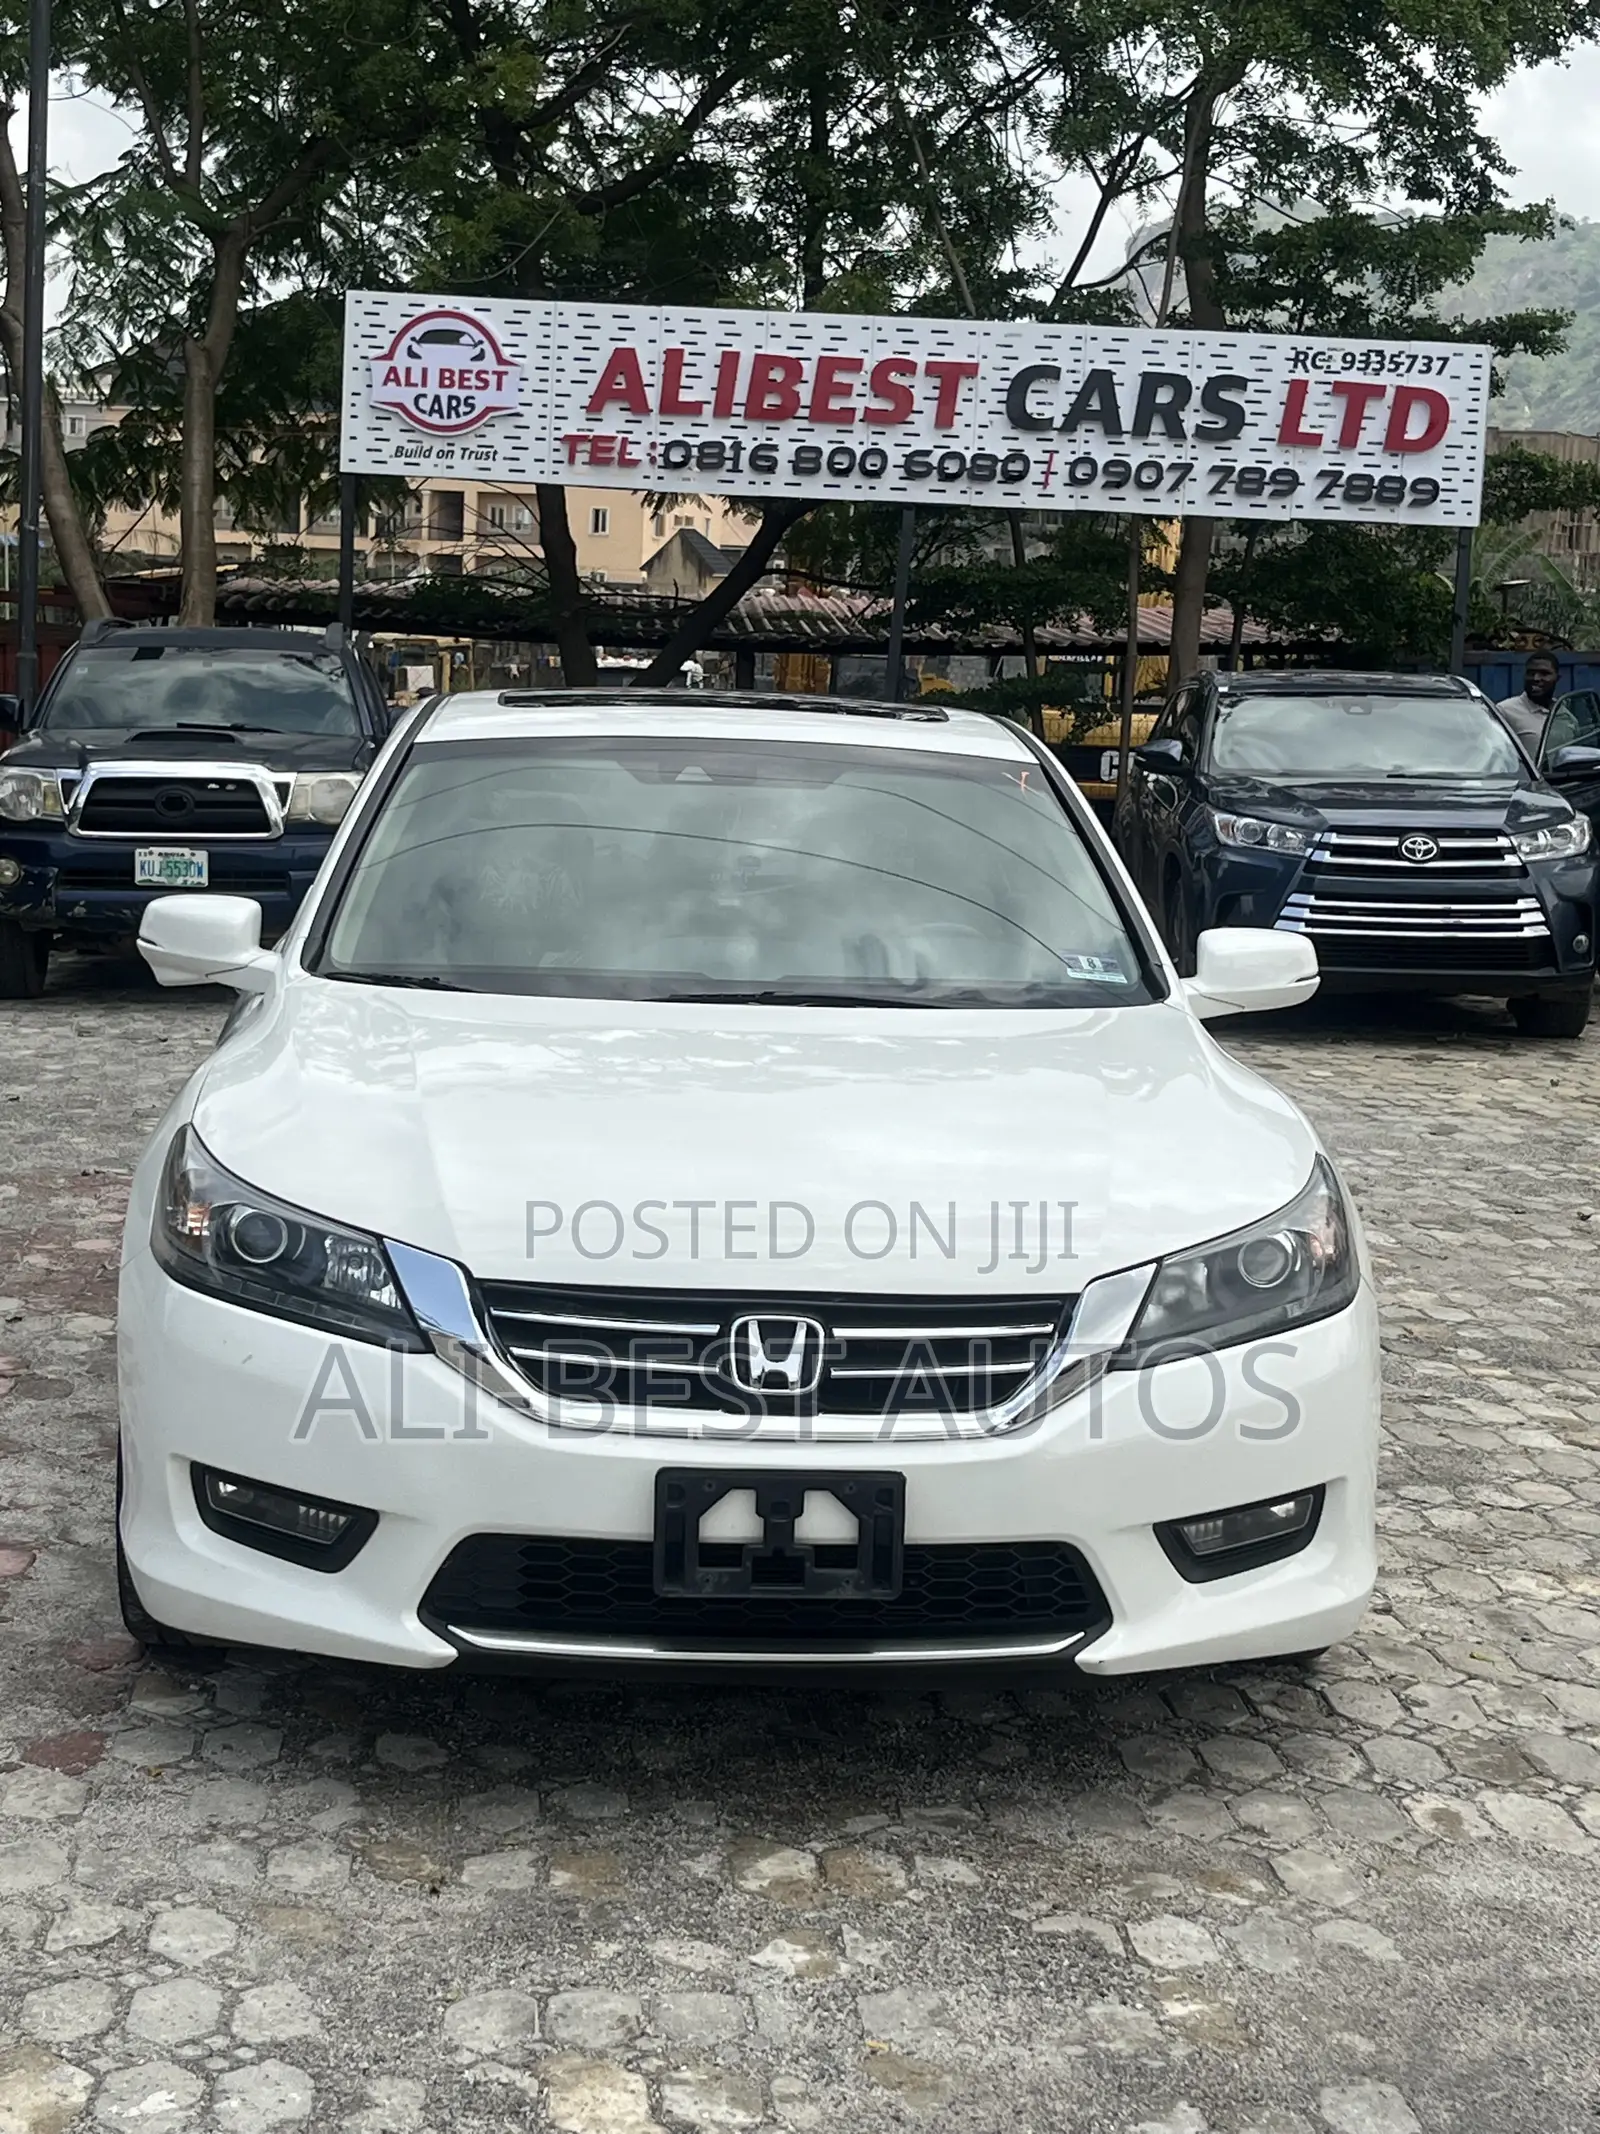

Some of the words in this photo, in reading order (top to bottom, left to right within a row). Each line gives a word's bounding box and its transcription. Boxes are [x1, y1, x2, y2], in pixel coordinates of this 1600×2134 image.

[1340, 351, 1450, 376] 9335737
[382, 366, 429, 388] ALI
[438, 367, 509, 392] BEST
[413, 393, 477, 420] CARS
[585, 347, 979, 425] ALIBEST
[1005, 364, 1249, 442] CARS
[1277, 379, 1451, 454] LTD
[394, 445, 433, 459] Build
[436, 448, 456, 460] on
[460, 447, 499, 461] Trust
[792, 445, 889, 479] 800
[903, 449, 1031, 483] 6080
[1067, 456, 1194, 493] 0907
[1206, 465, 1302, 498] 789
[1314, 468, 1442, 508] 7889
